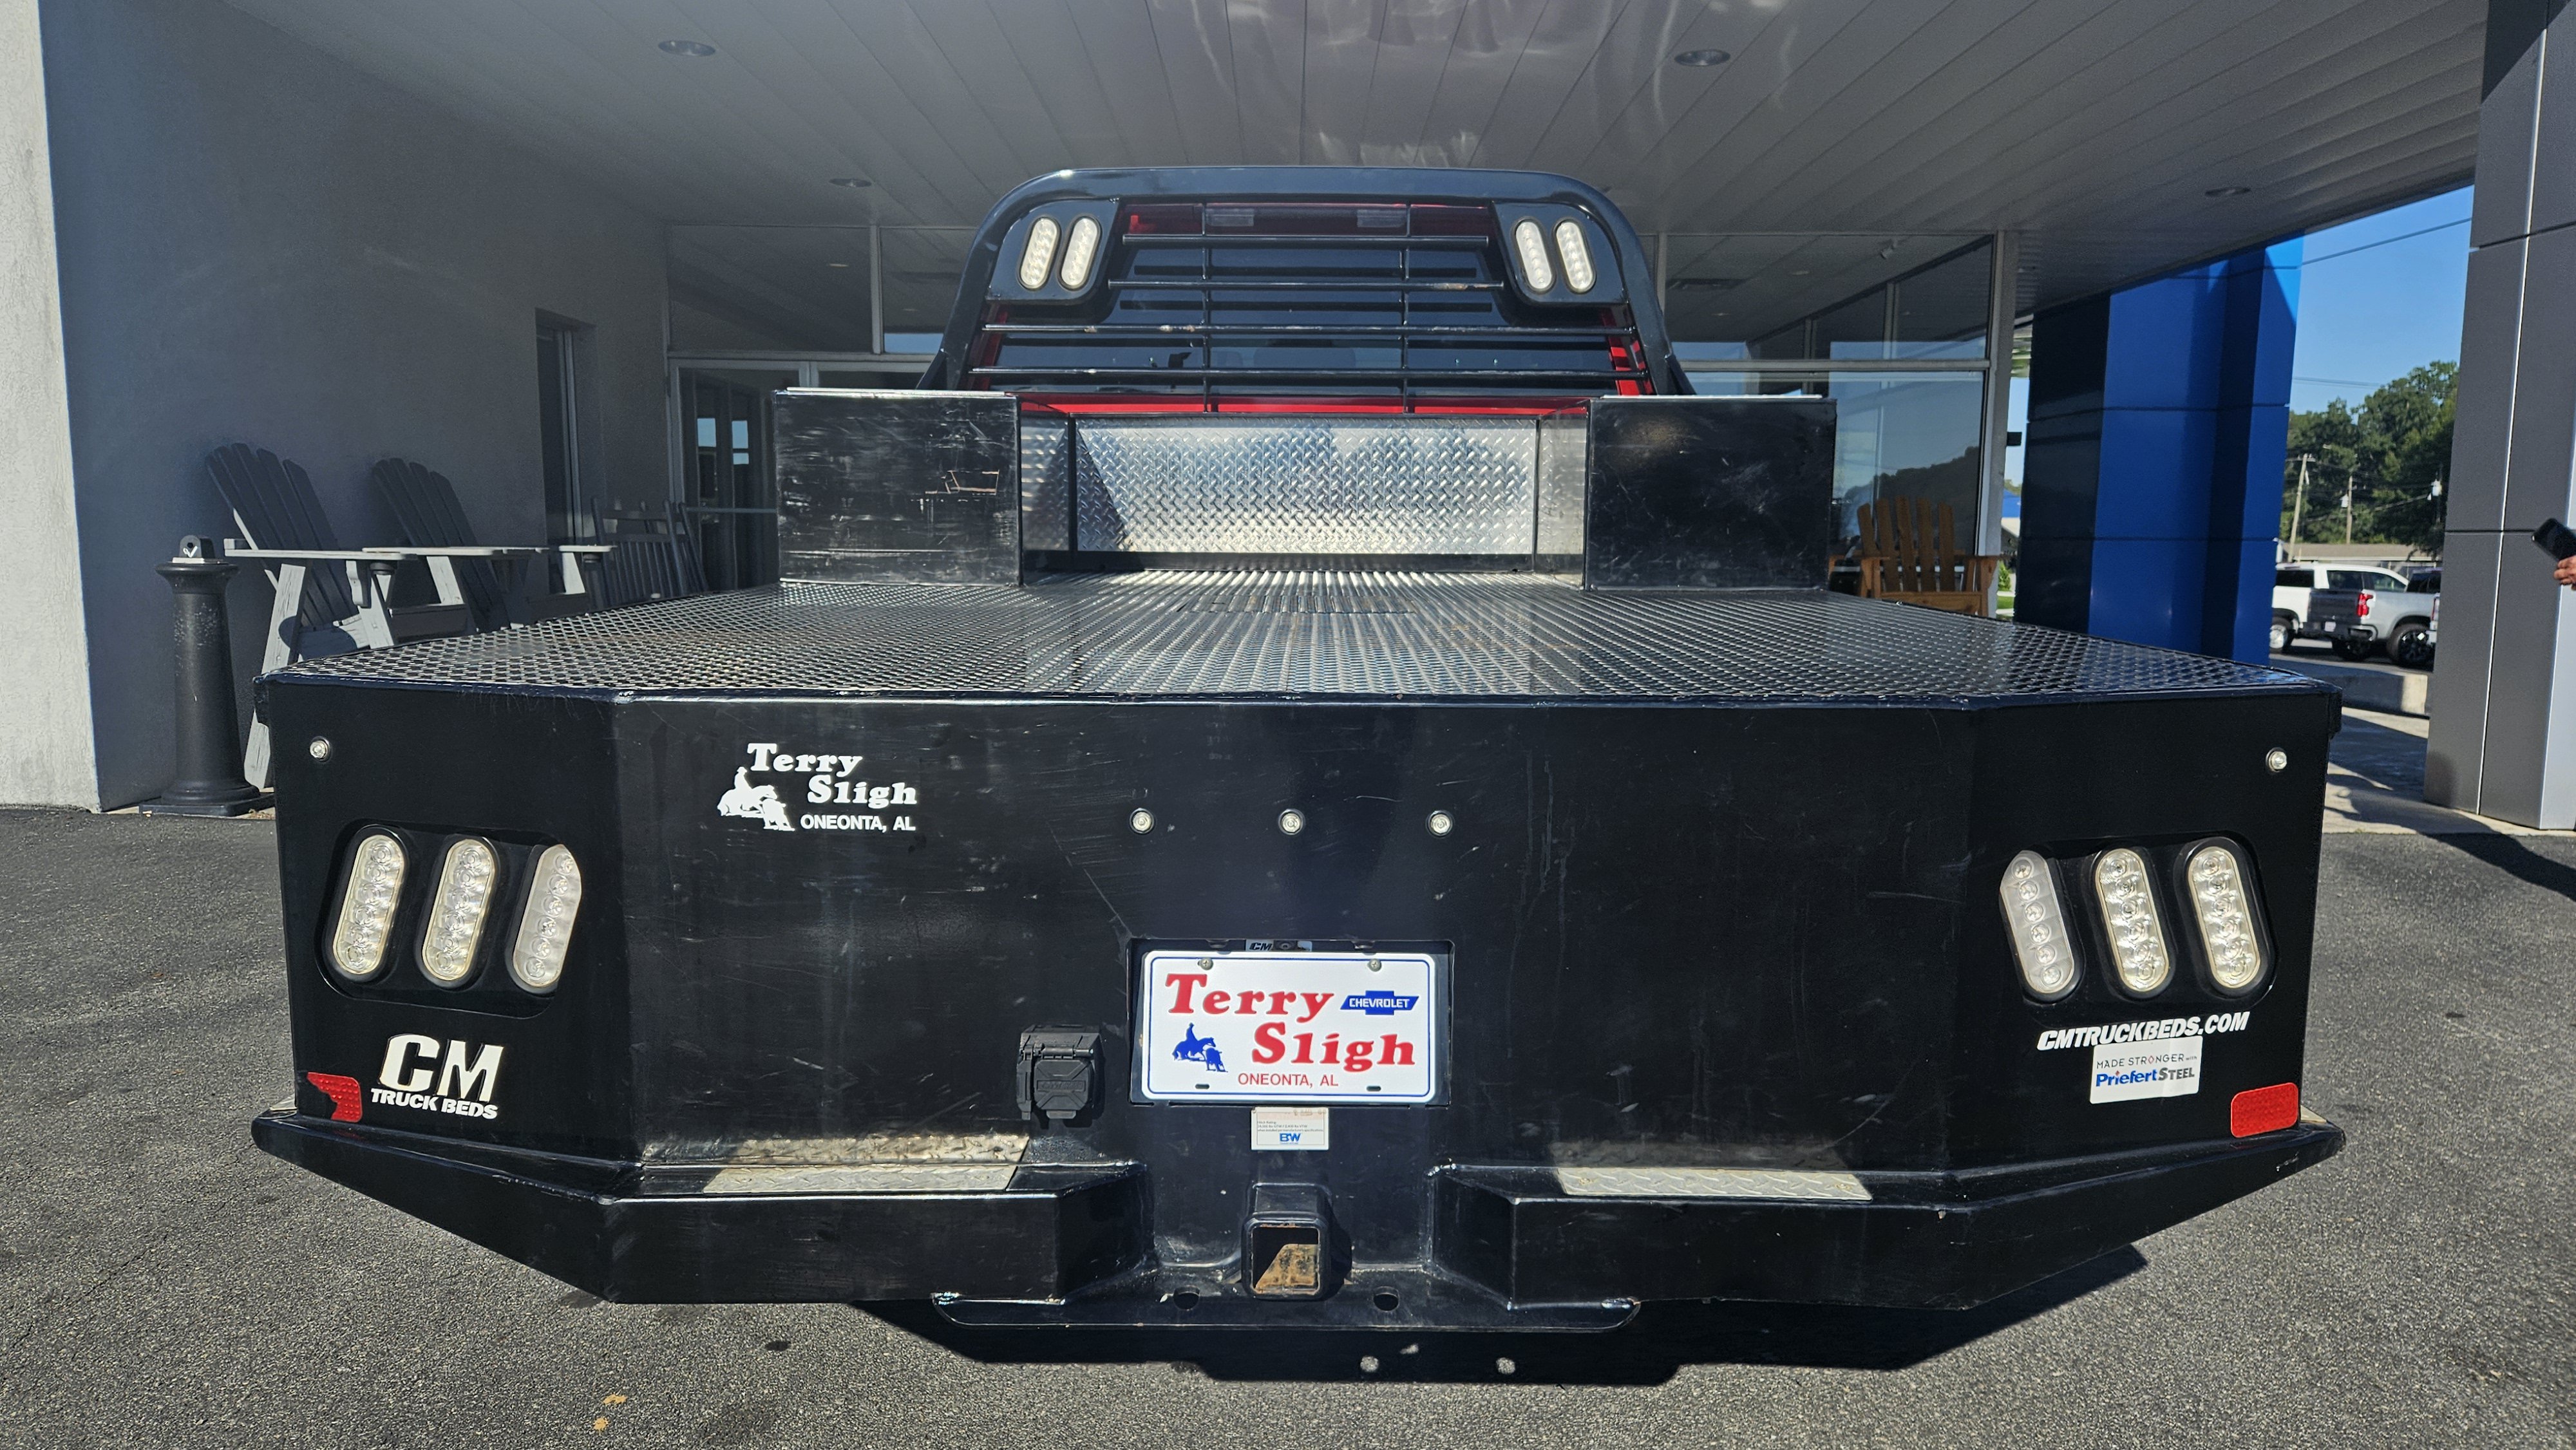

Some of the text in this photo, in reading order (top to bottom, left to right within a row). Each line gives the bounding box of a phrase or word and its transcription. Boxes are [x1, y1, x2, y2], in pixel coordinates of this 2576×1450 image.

[747, 742, 863, 777] Terry
[807, 774, 918, 809] Sligh
[800, 814, 916, 833] ONEONTA, AL
[1249, 942, 1273, 951] CM
[1165, 974, 1334, 1023] Terry
[1349, 998, 1410, 1008] CHEVROLET
[1251, 1022, 1415, 1072] Sligh
[2036, 1011, 2251, 1051] CMTRUCKBEDS.COM
[378, 1033, 504, 1102] CM
[2096, 1058, 2125, 1069] MADE
[2128, 1053, 2184, 1066] STRONGER
[1238, 1073, 1339, 1088] ONEONTA, AL
[371, 1088, 498, 1120] TRUCK BEDS
